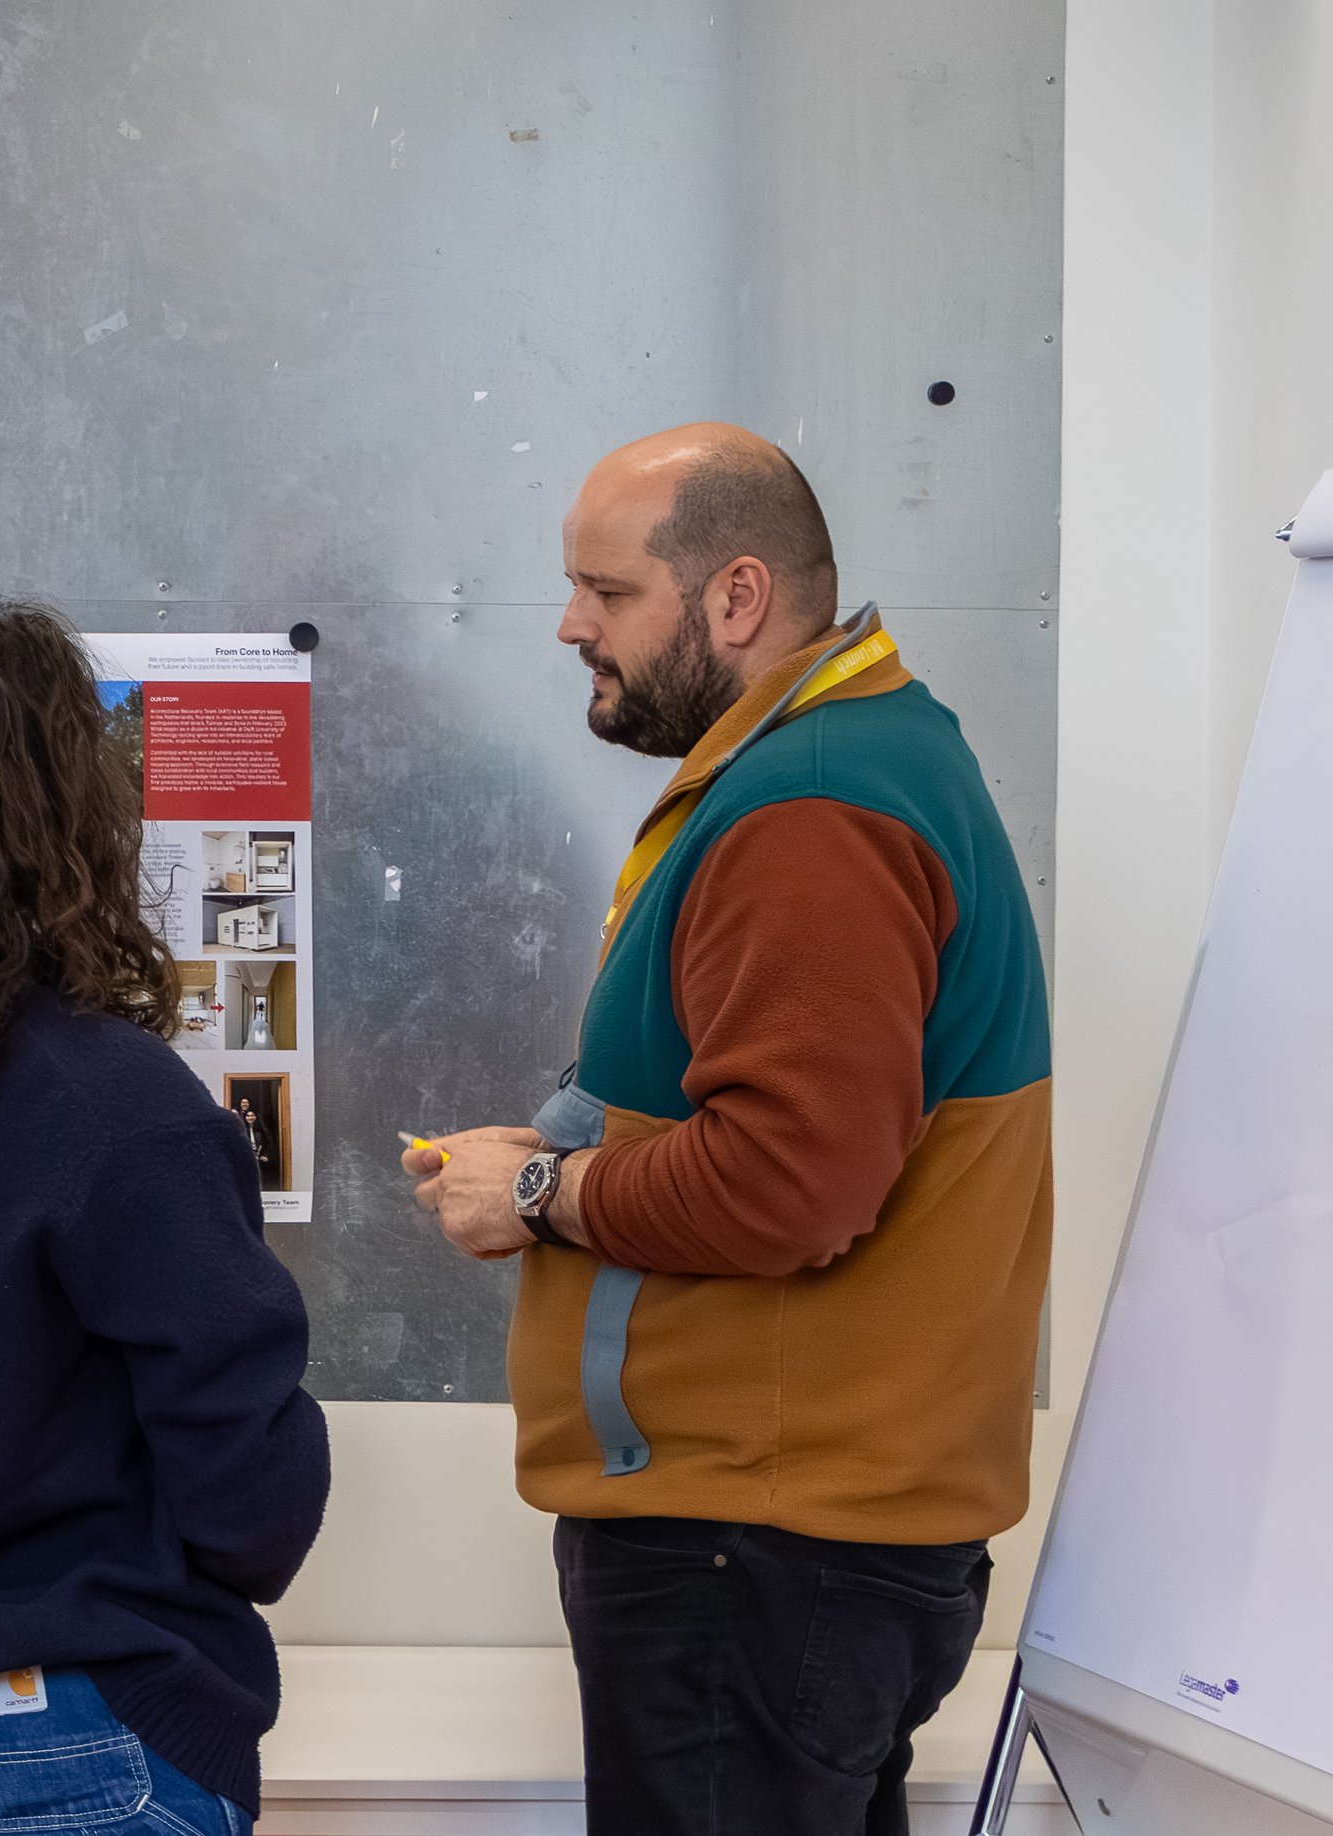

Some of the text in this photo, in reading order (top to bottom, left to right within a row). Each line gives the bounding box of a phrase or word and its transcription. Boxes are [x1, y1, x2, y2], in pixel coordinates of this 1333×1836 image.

[215, 647, 298, 656] From Core to Home
